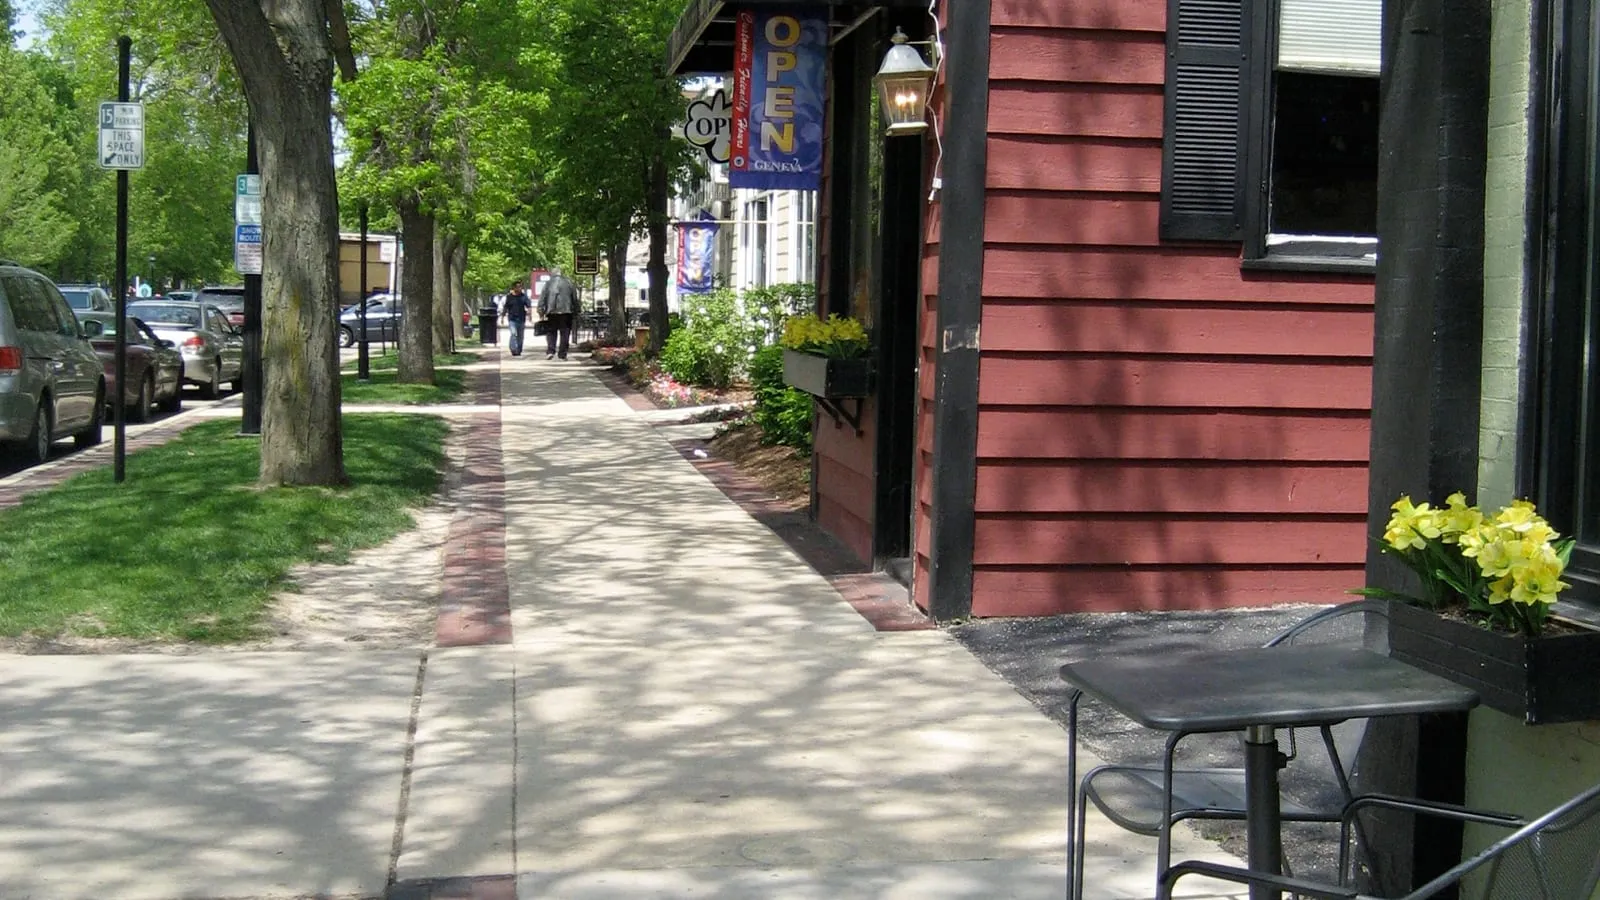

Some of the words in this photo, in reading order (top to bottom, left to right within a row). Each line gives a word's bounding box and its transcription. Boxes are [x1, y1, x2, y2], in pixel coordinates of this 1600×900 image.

[740, 12, 753, 62] Customer
[735, 67, 751, 113] Friendly
[760, 15, 800, 154] OPEN
[101, 108, 113, 124] 15
[115, 117, 141, 126] PARKING
[695, 117, 732, 136] OP
[735, 117, 748, 149] Hours
[112, 130, 132, 141] THIS
[106, 141, 135, 153] SPACE
[117, 154, 140, 165] ONLY
[754, 158, 803, 172] GENEVA
[239, 178, 247, 191] 3
